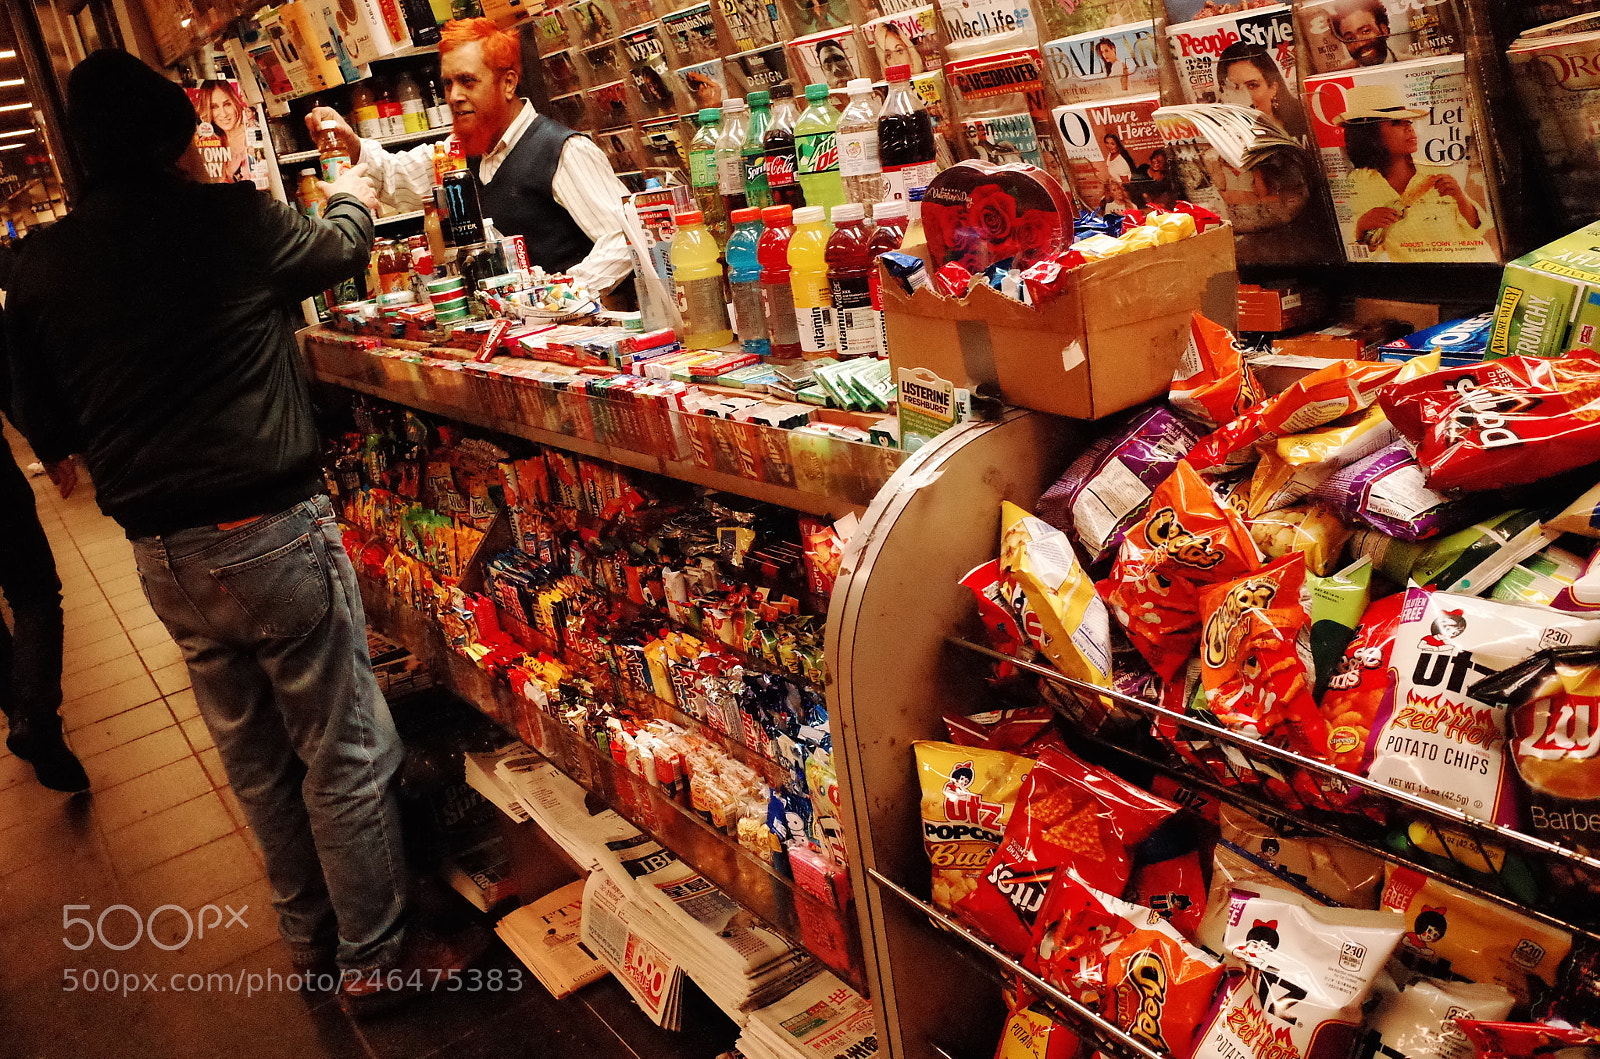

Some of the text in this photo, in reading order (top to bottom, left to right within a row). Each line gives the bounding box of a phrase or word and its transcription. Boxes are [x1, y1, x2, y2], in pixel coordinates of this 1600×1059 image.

[1177, 18, 1294, 57] People Style
[1409, 35, 1454, 52] ATLANTA'S
[747, 71, 783, 87] DESIGN
[1190, 74, 1214, 84] GIFTS
[1059, 108, 1138, 147] O Where
[1429, 106, 1464, 126] Let
[1118, 123, 1157, 140] Here?
[1449, 125, 1461, 141] It
[1424, 136, 1472, 163] Go!
[811, 307, 827, 350] vitamin
[837, 311, 850, 351] vitamin
[1492, 288, 1519, 353] NATURE VALLEY
[902, 381, 950, 406] LISTERINE
[904, 395, 948, 414] FRESHBURST
[1401, 606, 1423, 622] FREE
[1545, 628, 1569, 646] 230
[1391, 704, 1507, 752] Red Hot
[1385, 735, 1490, 776] POTATO CHIPS
[1387, 776, 1404, 788] NET
[1405, 781, 1417, 791] WT
[1440, 790, 1471, 806] (42.5g)
[946, 795, 1004, 832] utz
[1384, 888, 1410, 909] FREE
[1345, 943, 1364, 959] 230
[1010, 1023, 1032, 1049] POTATO
